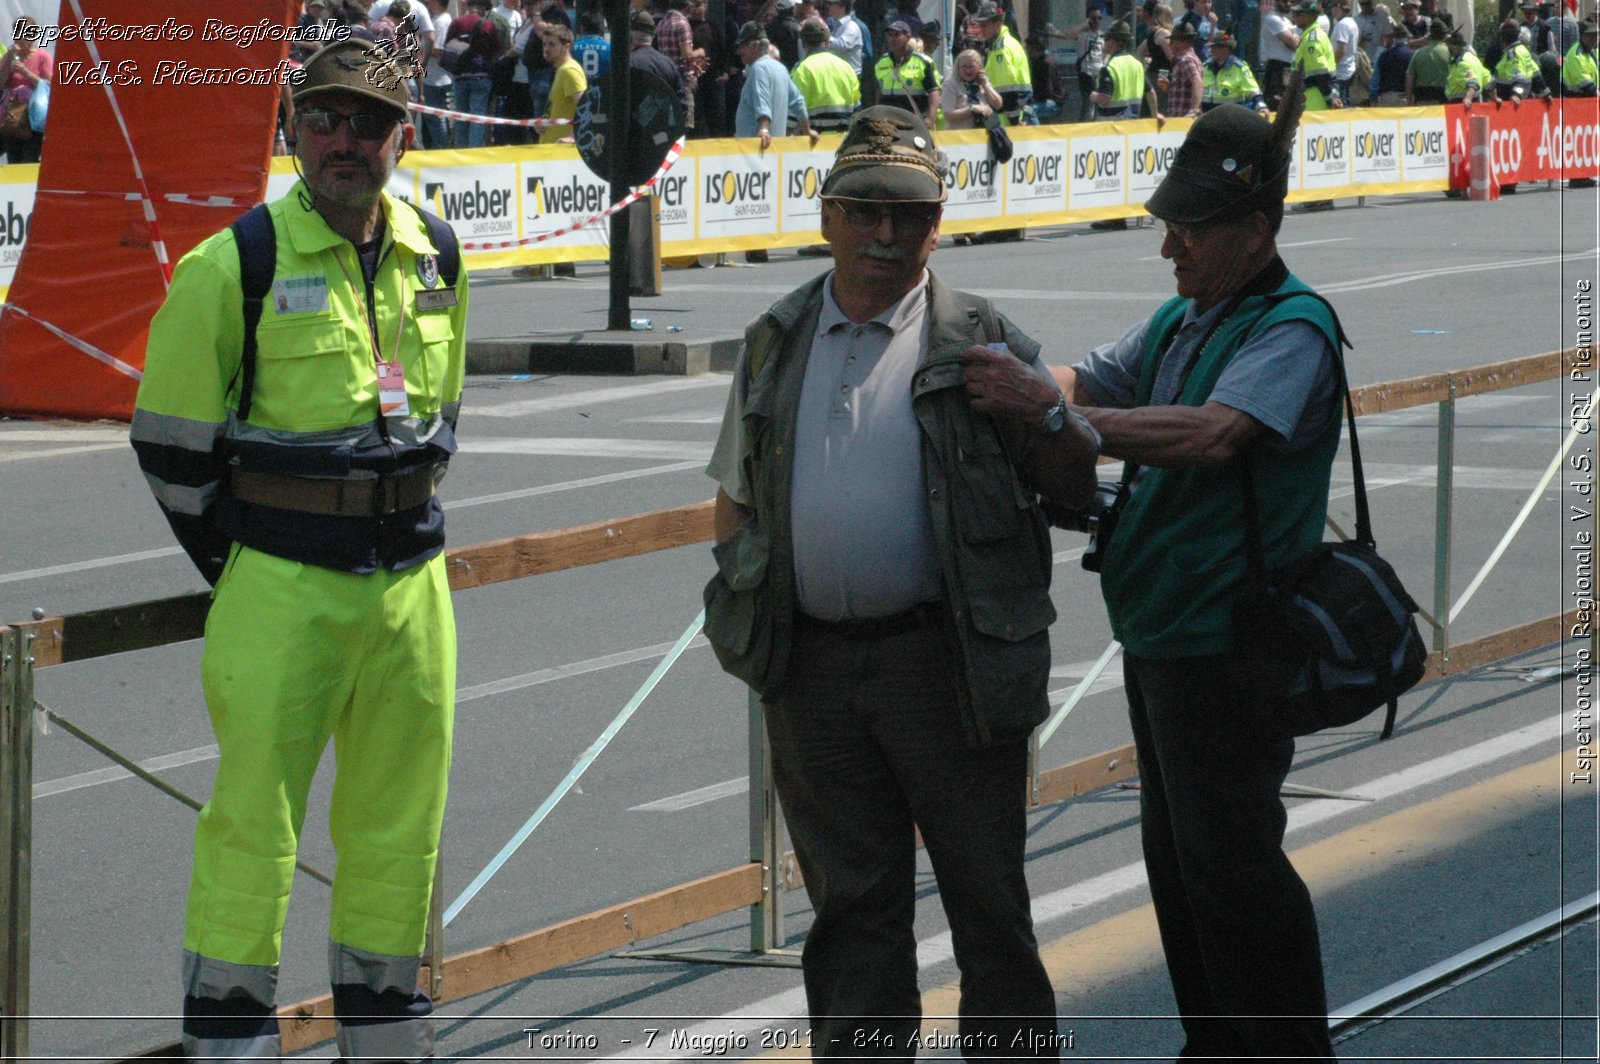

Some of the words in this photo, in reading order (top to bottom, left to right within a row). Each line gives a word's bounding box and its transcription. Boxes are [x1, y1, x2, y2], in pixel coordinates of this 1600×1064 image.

[574, 43, 608, 51] PLAYER
[582, 49, 599, 76] 8
[1537, 112, 1600, 170] Adecco
[443, 180, 511, 221] weber
[543, 174, 606, 214] weber
[652, 175, 688, 207] ver
[472, 221, 513, 235] SAINT-GOBAIN
